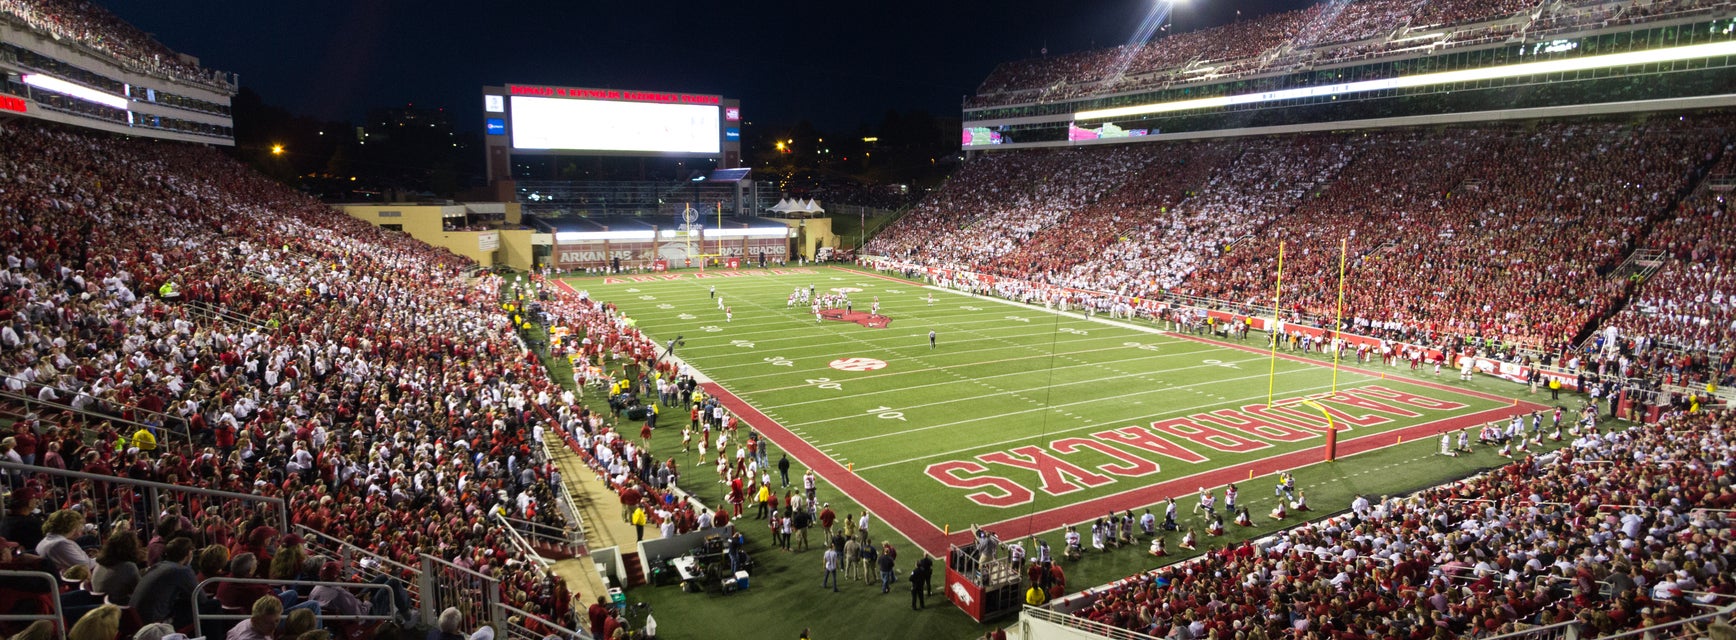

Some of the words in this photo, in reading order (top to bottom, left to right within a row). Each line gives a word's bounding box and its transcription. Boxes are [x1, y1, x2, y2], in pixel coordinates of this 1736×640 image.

[805, 377, 841, 389] 20
[866, 405, 904, 419] 10
[924, 385, 1470, 508] RAZORBACKS
